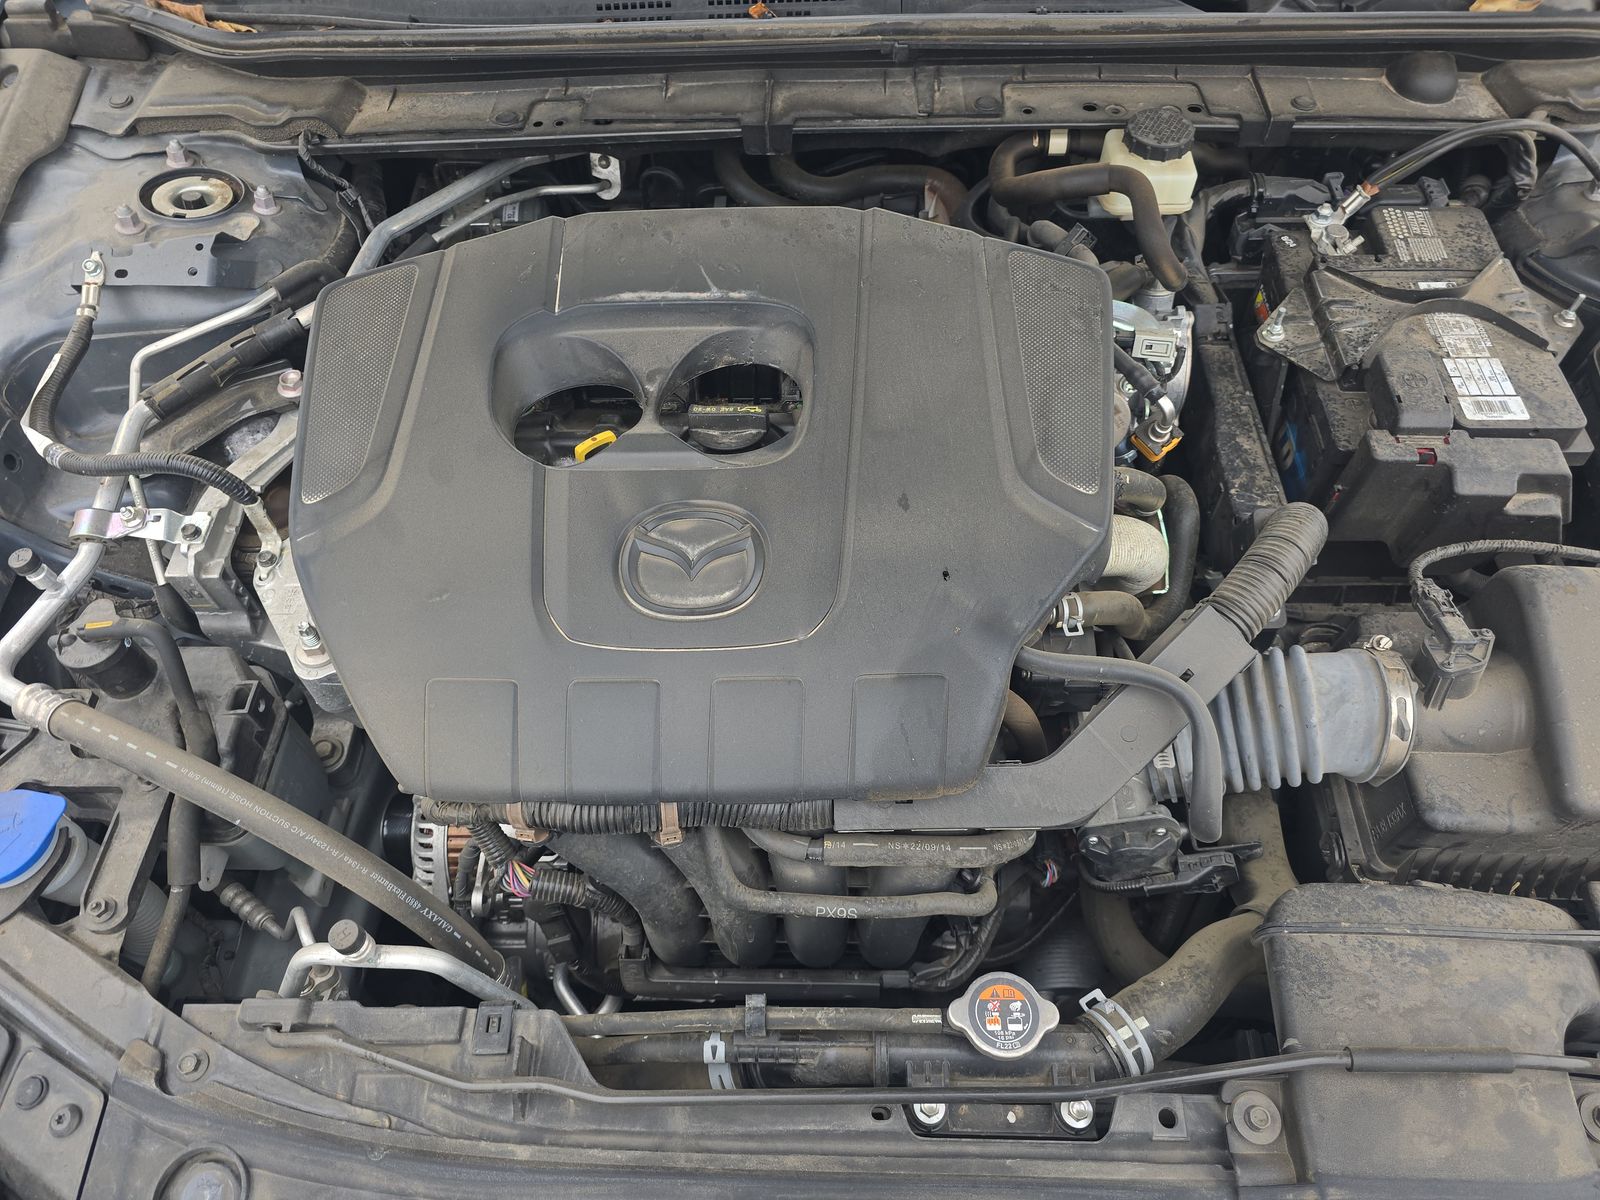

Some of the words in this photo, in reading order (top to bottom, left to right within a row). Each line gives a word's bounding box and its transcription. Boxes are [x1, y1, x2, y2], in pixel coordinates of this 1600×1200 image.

[1406, 211, 1420, 234] BATTERY
[188, 771, 201, 781] 5/8
[201, 777, 230, 795] (16mm)
[229, 792, 254, 808] HOSE
[254, 804, 289, 829] SUCTION
[290, 827, 306, 838] A/C
[342, 854, 368, 874] R-134a
[370, 871, 405, 900] FlexBarrier
[405, 896, 422, 910] 4880
[420, 908, 453, 933] GALAXY
[815, 906, 858, 919] PX9S
